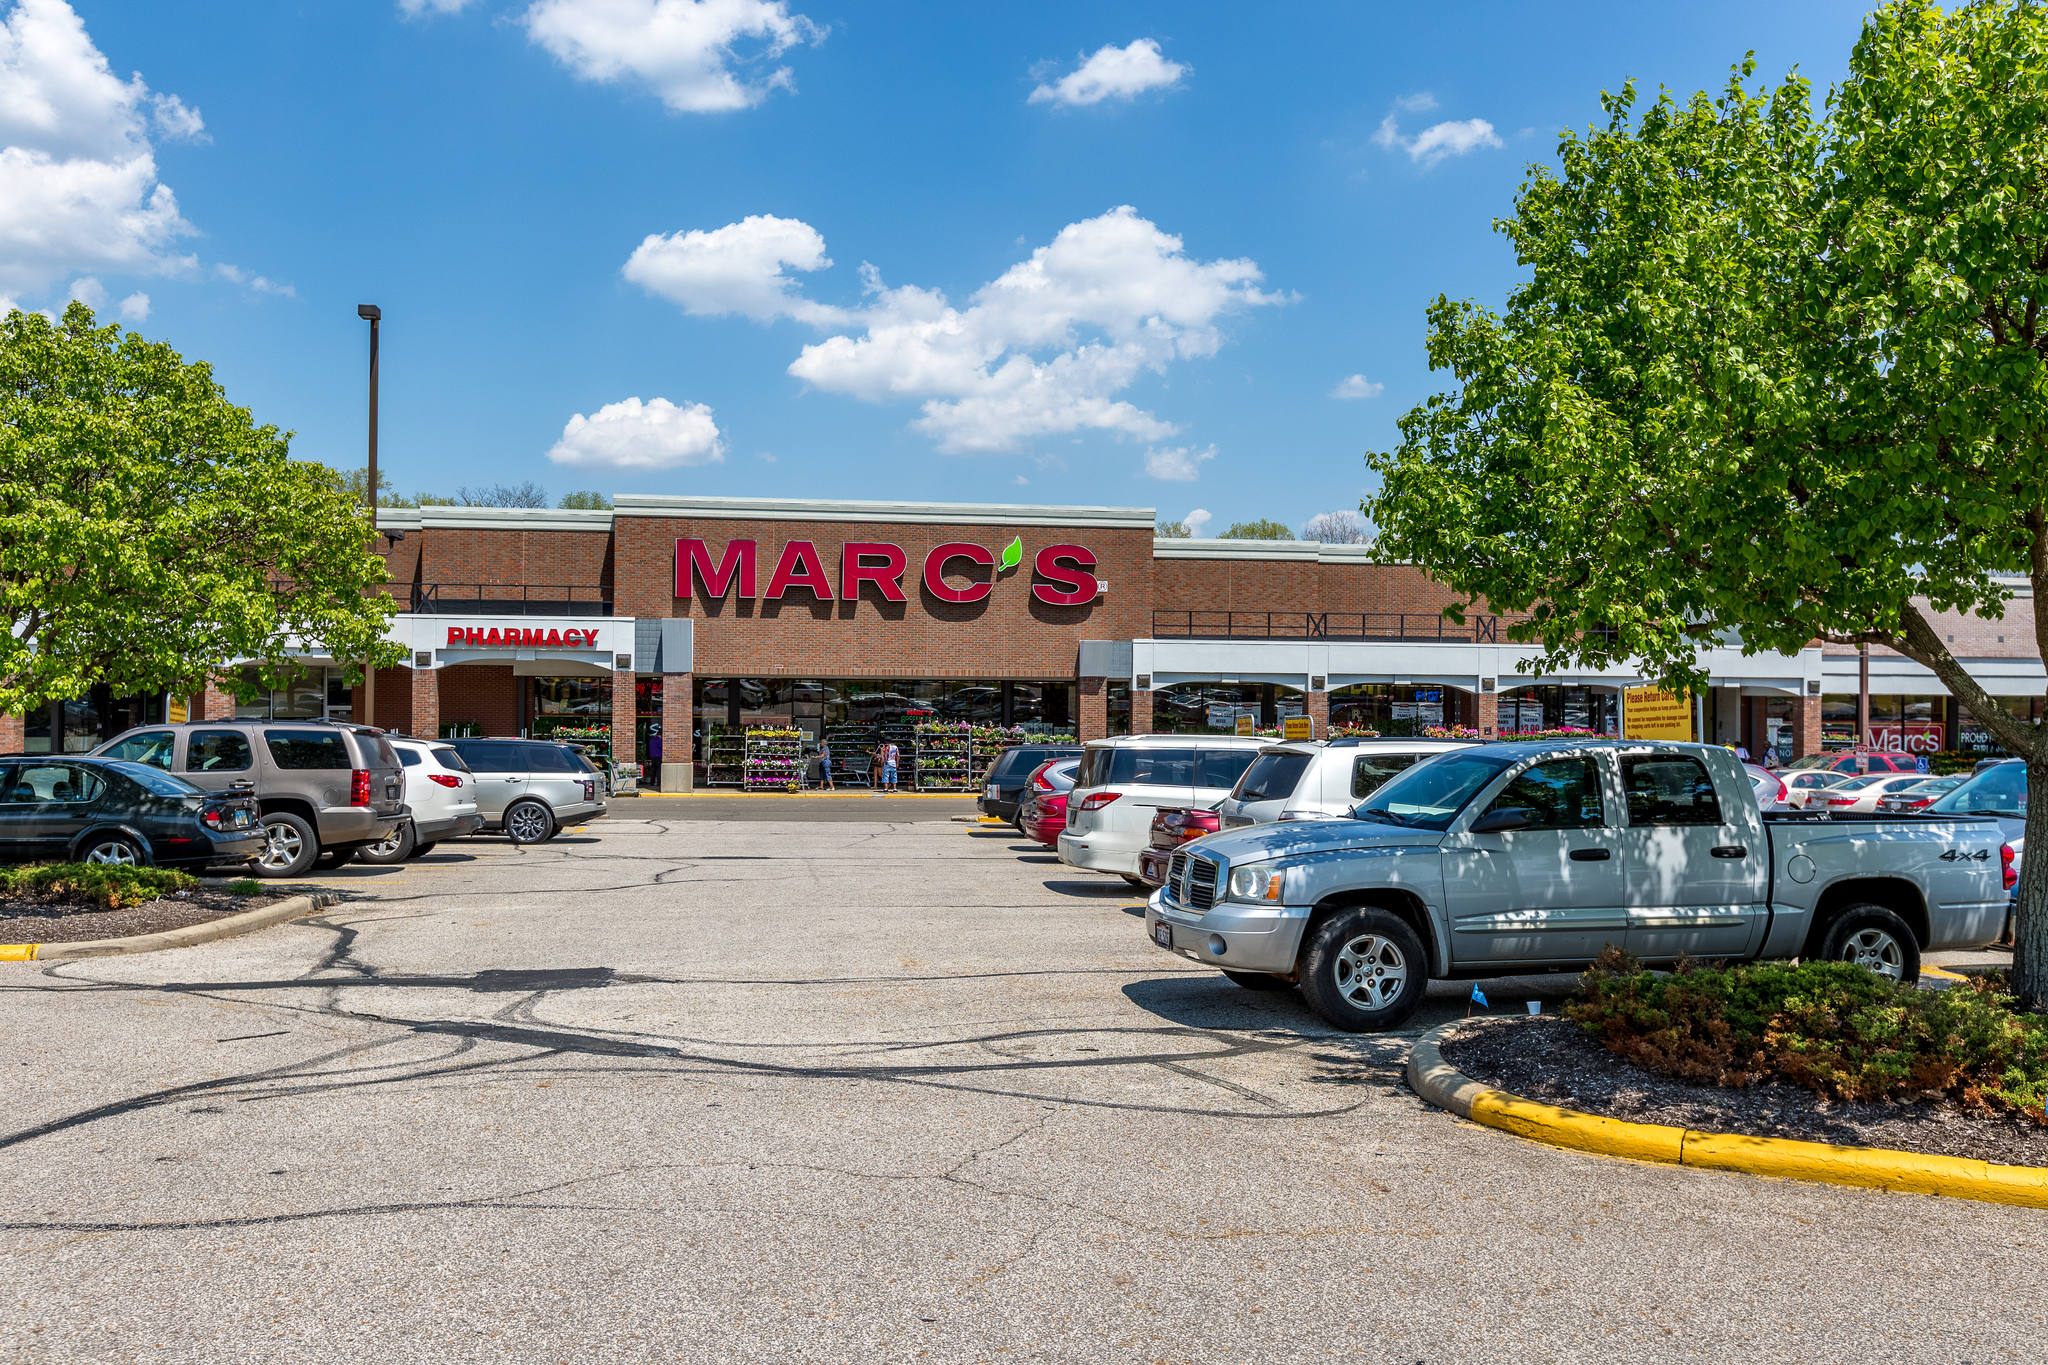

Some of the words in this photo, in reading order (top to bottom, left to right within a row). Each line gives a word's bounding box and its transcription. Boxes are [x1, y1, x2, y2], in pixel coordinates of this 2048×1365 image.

[674, 536, 1098, 605] MARC'S
[447, 626, 599, 647] PHARMACY
[1627, 692, 1643, 704] Please
[1644, 691, 1660, 702] Return
[1960, 731, 1988, 744] PROUD
